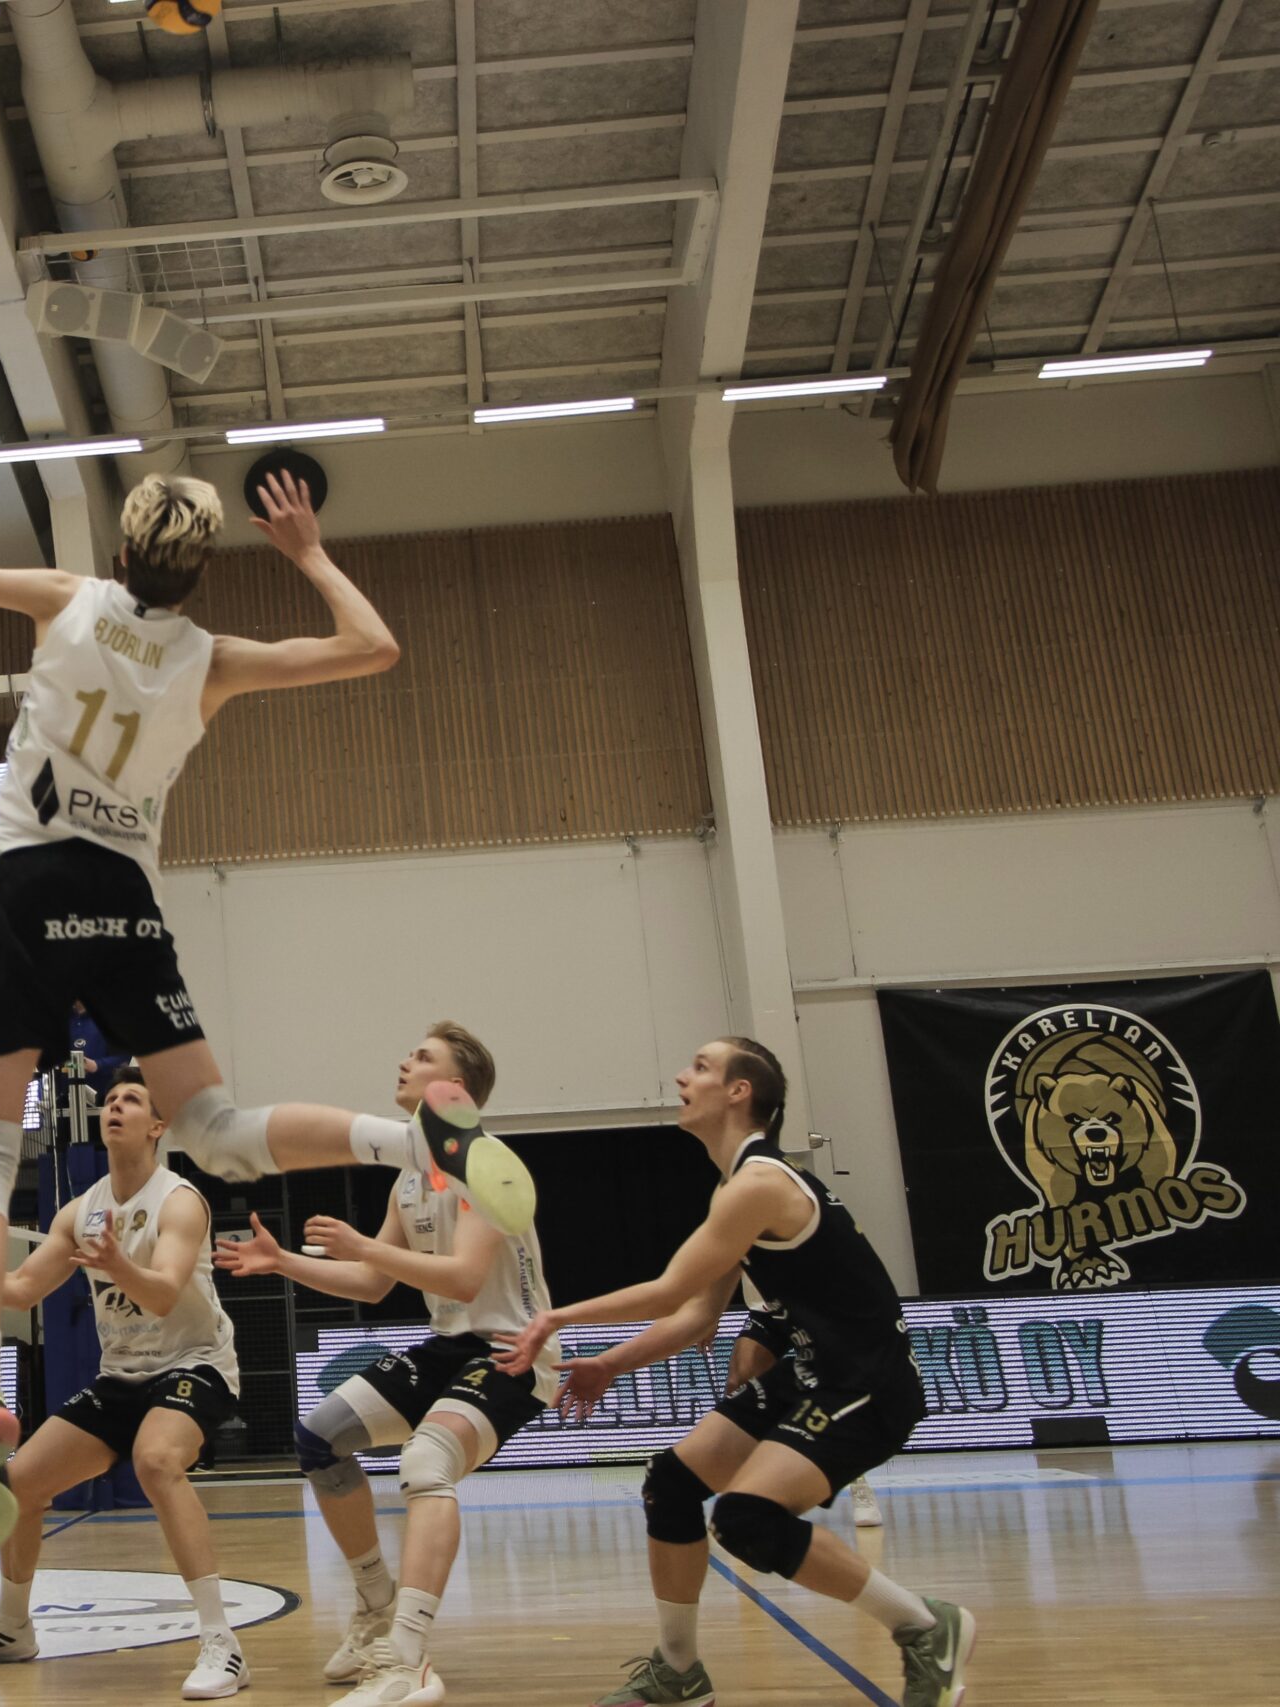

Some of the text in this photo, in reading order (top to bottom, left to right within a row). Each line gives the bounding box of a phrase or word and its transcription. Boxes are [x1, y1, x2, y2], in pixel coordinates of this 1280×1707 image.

[94, 617, 164, 670] BJÖRLIN
[69, 688, 141, 782] 11
[69, 788, 138, 828] PKS
[1001, 1010, 1163, 1071] KARELIAN
[990, 1168, 1237, 1273] HURMOS
[176, 1379, 193, 1398] 8
[463, 1368, 489, 1384] 4
[1017, 1319, 1111, 1409] OY
